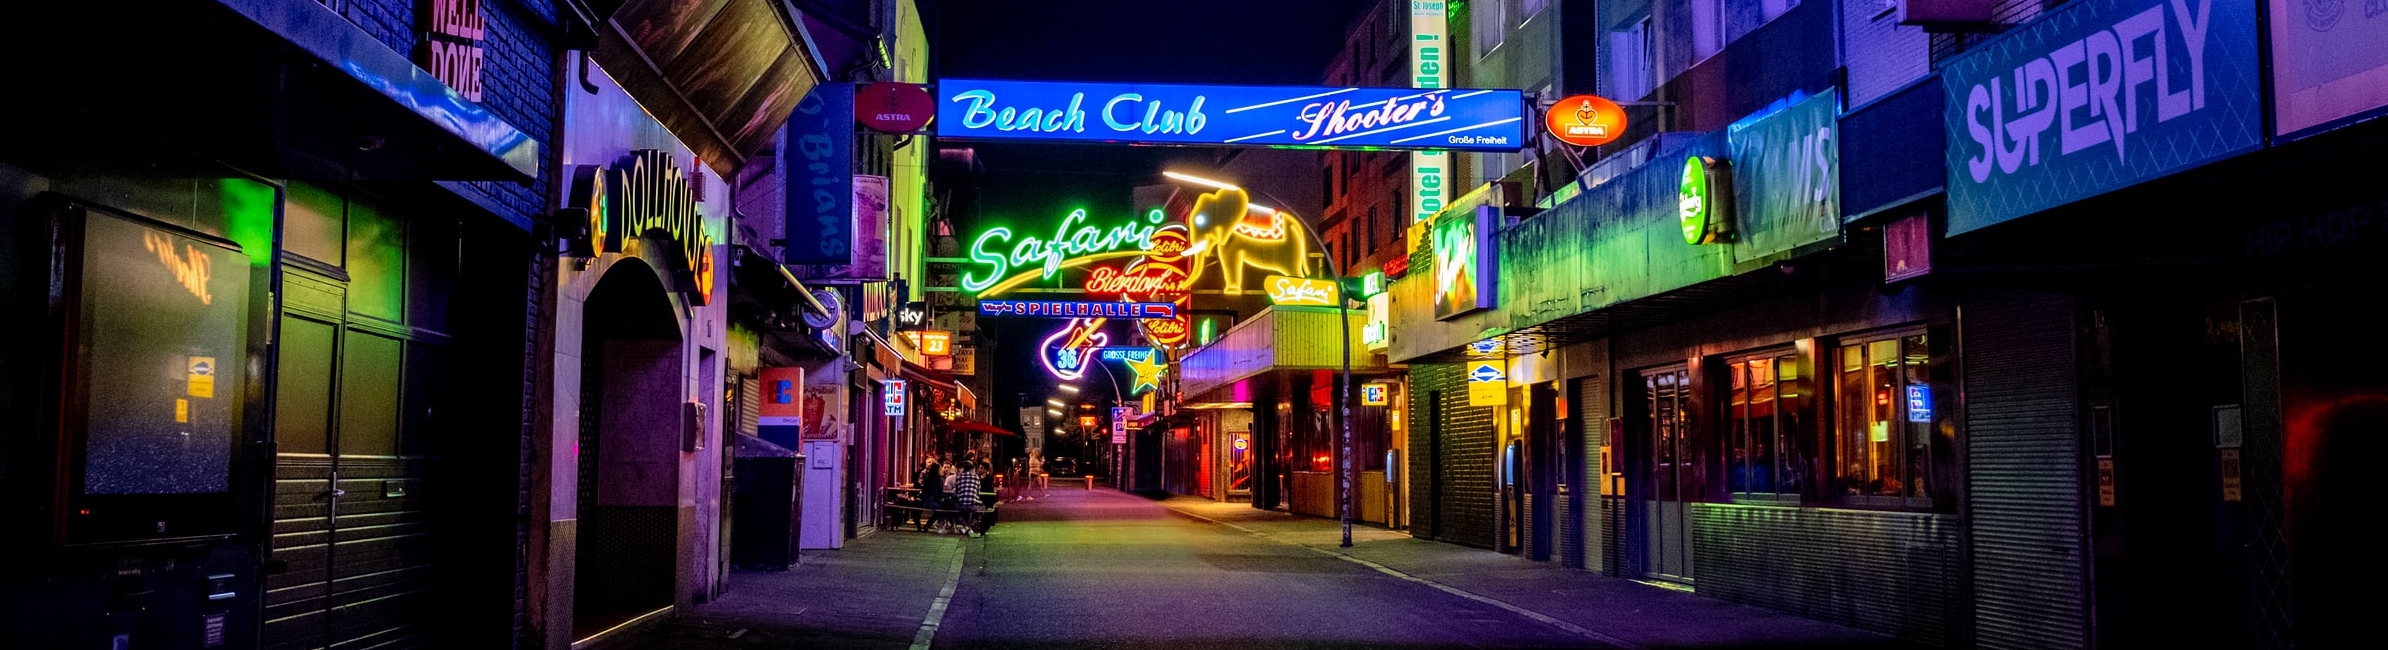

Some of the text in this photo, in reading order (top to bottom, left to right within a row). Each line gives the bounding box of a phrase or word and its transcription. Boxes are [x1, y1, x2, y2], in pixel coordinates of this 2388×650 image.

[433, 0, 485, 40] WELL
[431, 40, 483, 102] DONE
[1966, 0, 2212, 184] SUPERFLY
[875, 113, 911, 121] ASTRA
[951, 89, 1207, 135] Beach Club
[1291, 92, 1446, 141] Shooter's
[1448, 136, 1507, 145] Große Freiheit
[1568, 126, 1606, 136] ASTRA
[962, 208, 1165, 292] Safari
[1151, 239, 1185, 252] Colibri
[1085, 265, 1173, 299] Bierdorf
[1270, 278, 1334, 301] Safari
[900, 308, 924, 326] sky
[1014, 303, 1141, 316] SPIELHALLE
[1149, 319, 1185, 333] Colibri
[928, 340, 944, 352] 23
[1103, 350, 1149, 360] GROSSE FREIHE
[1057, 349, 1078, 369] 36
